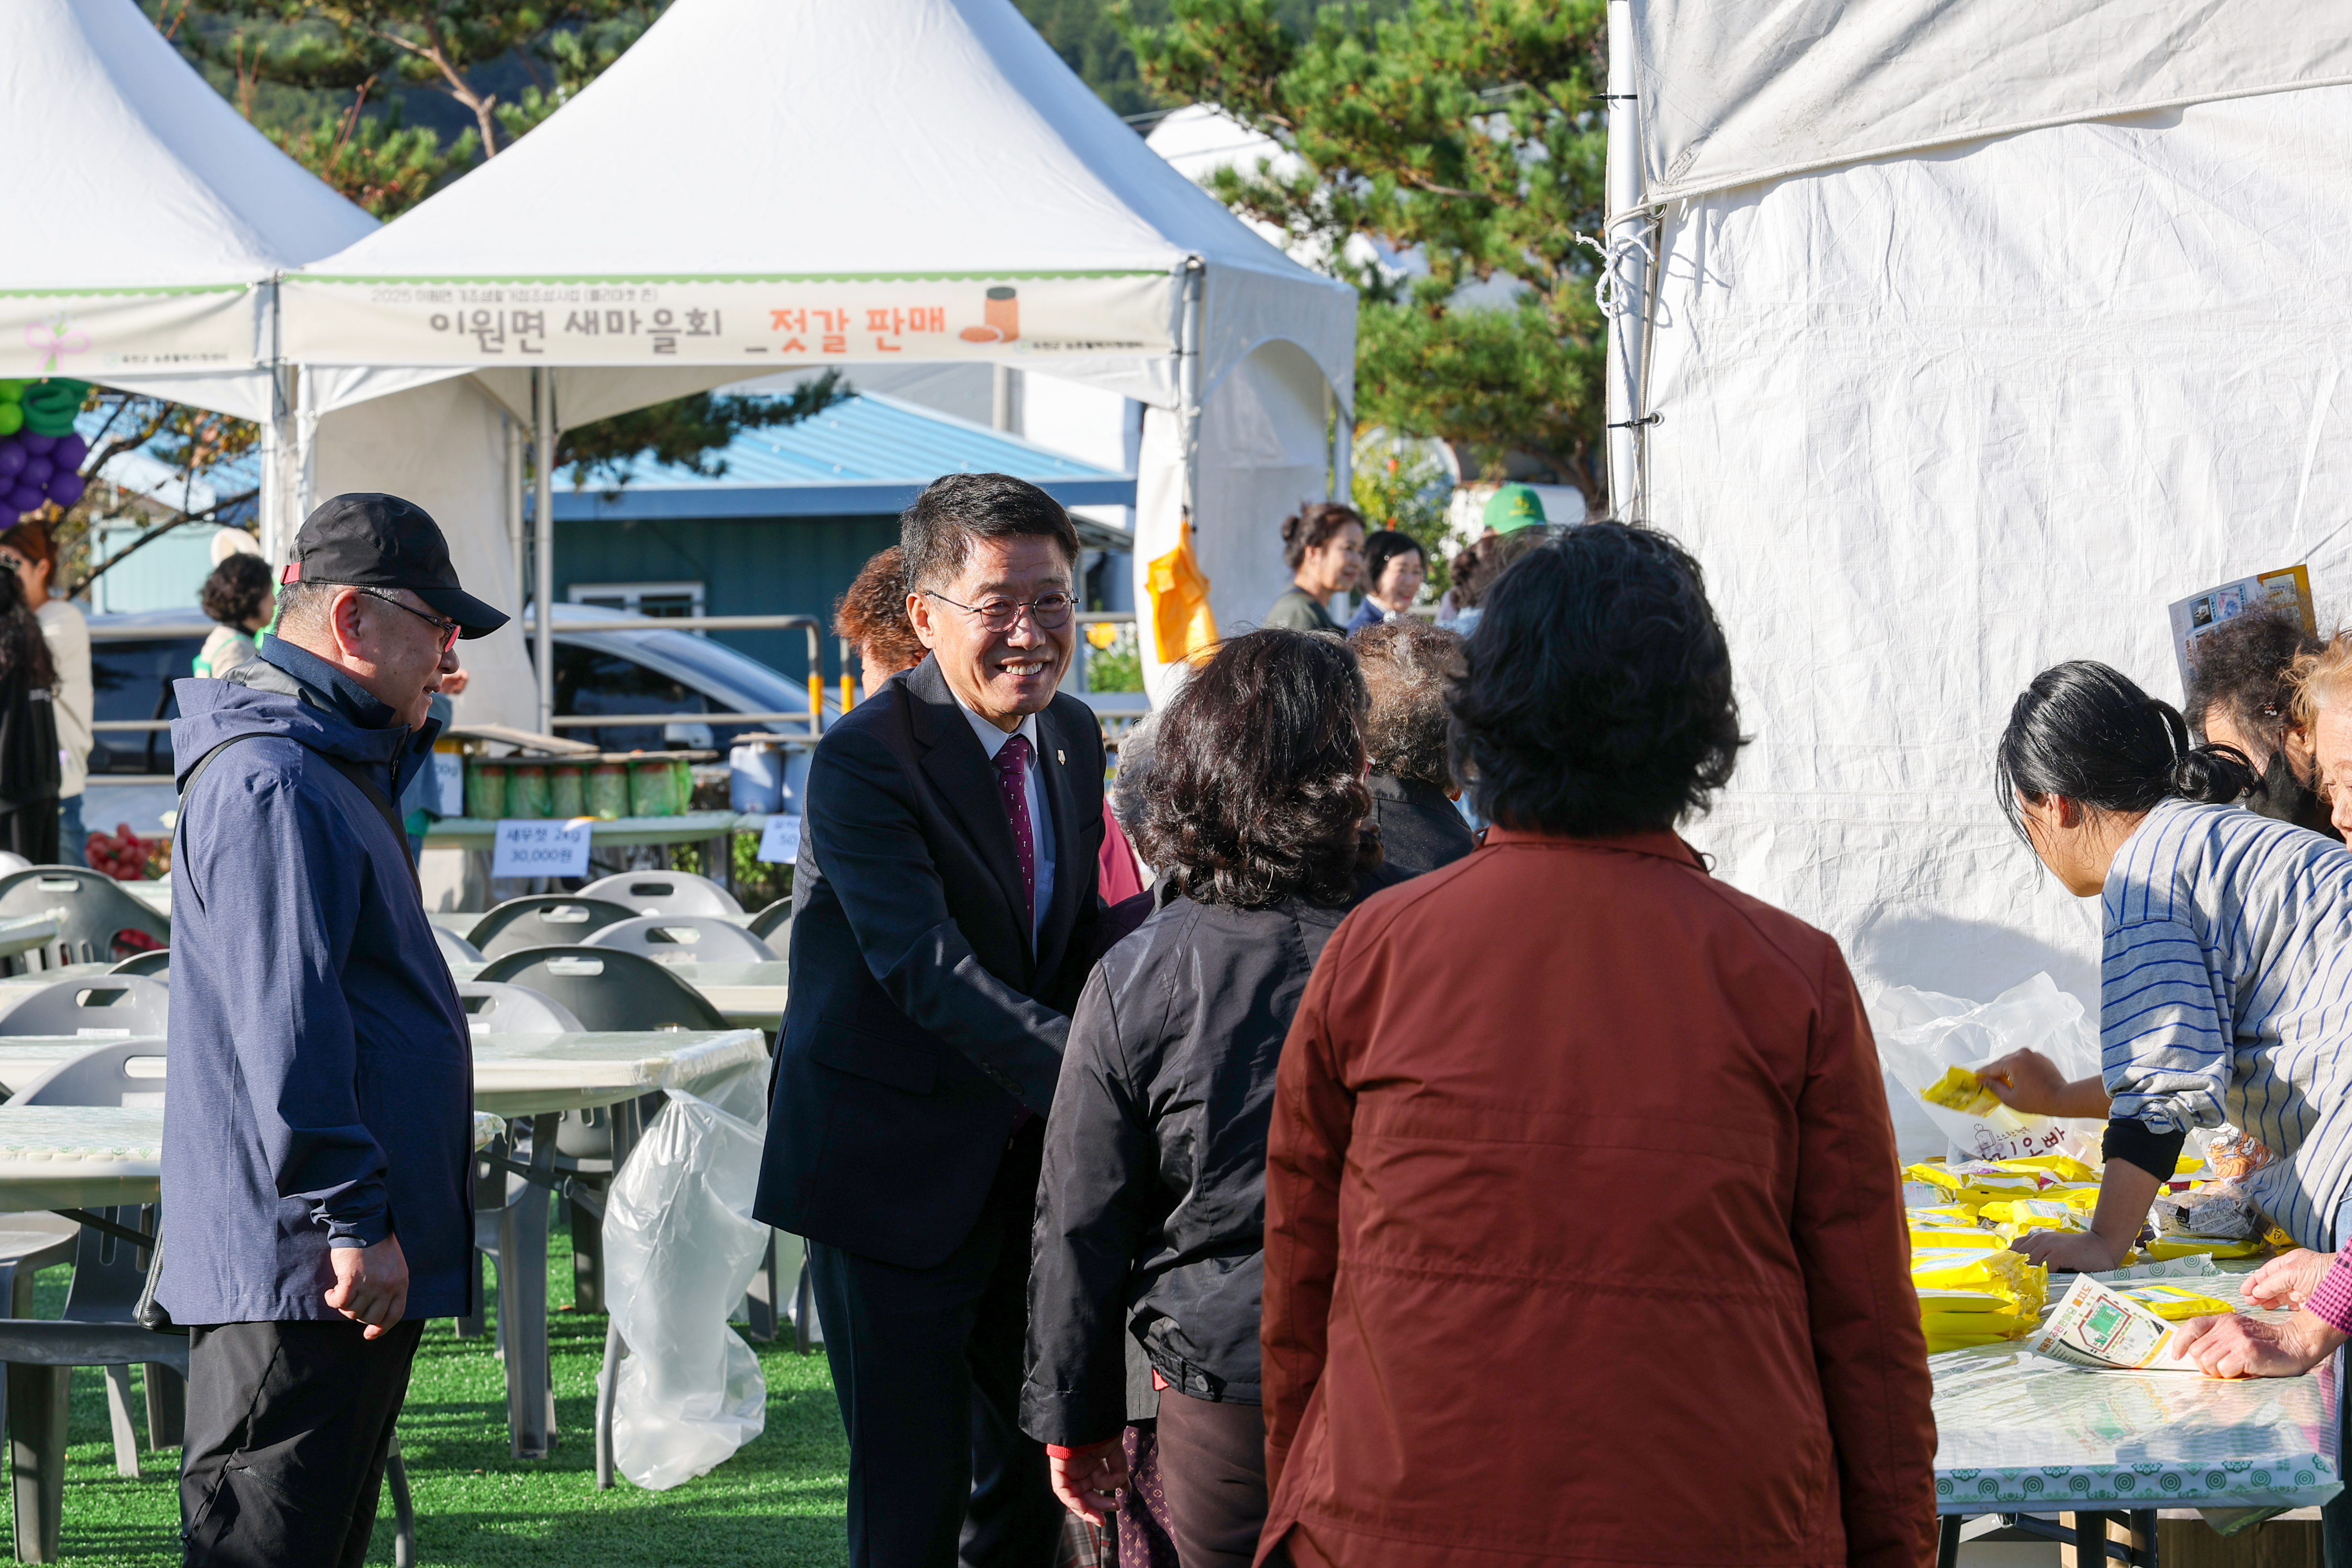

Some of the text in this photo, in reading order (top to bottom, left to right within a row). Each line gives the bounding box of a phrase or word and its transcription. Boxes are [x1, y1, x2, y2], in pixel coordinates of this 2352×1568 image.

[429, 308, 545, 354] 이원면
[564, 308, 722, 354] 새마을회
[866, 306, 945, 352] 판매
[506, 825, 581, 844] 새우젓 2kg
[510, 848, 573, 864] 30,000원
